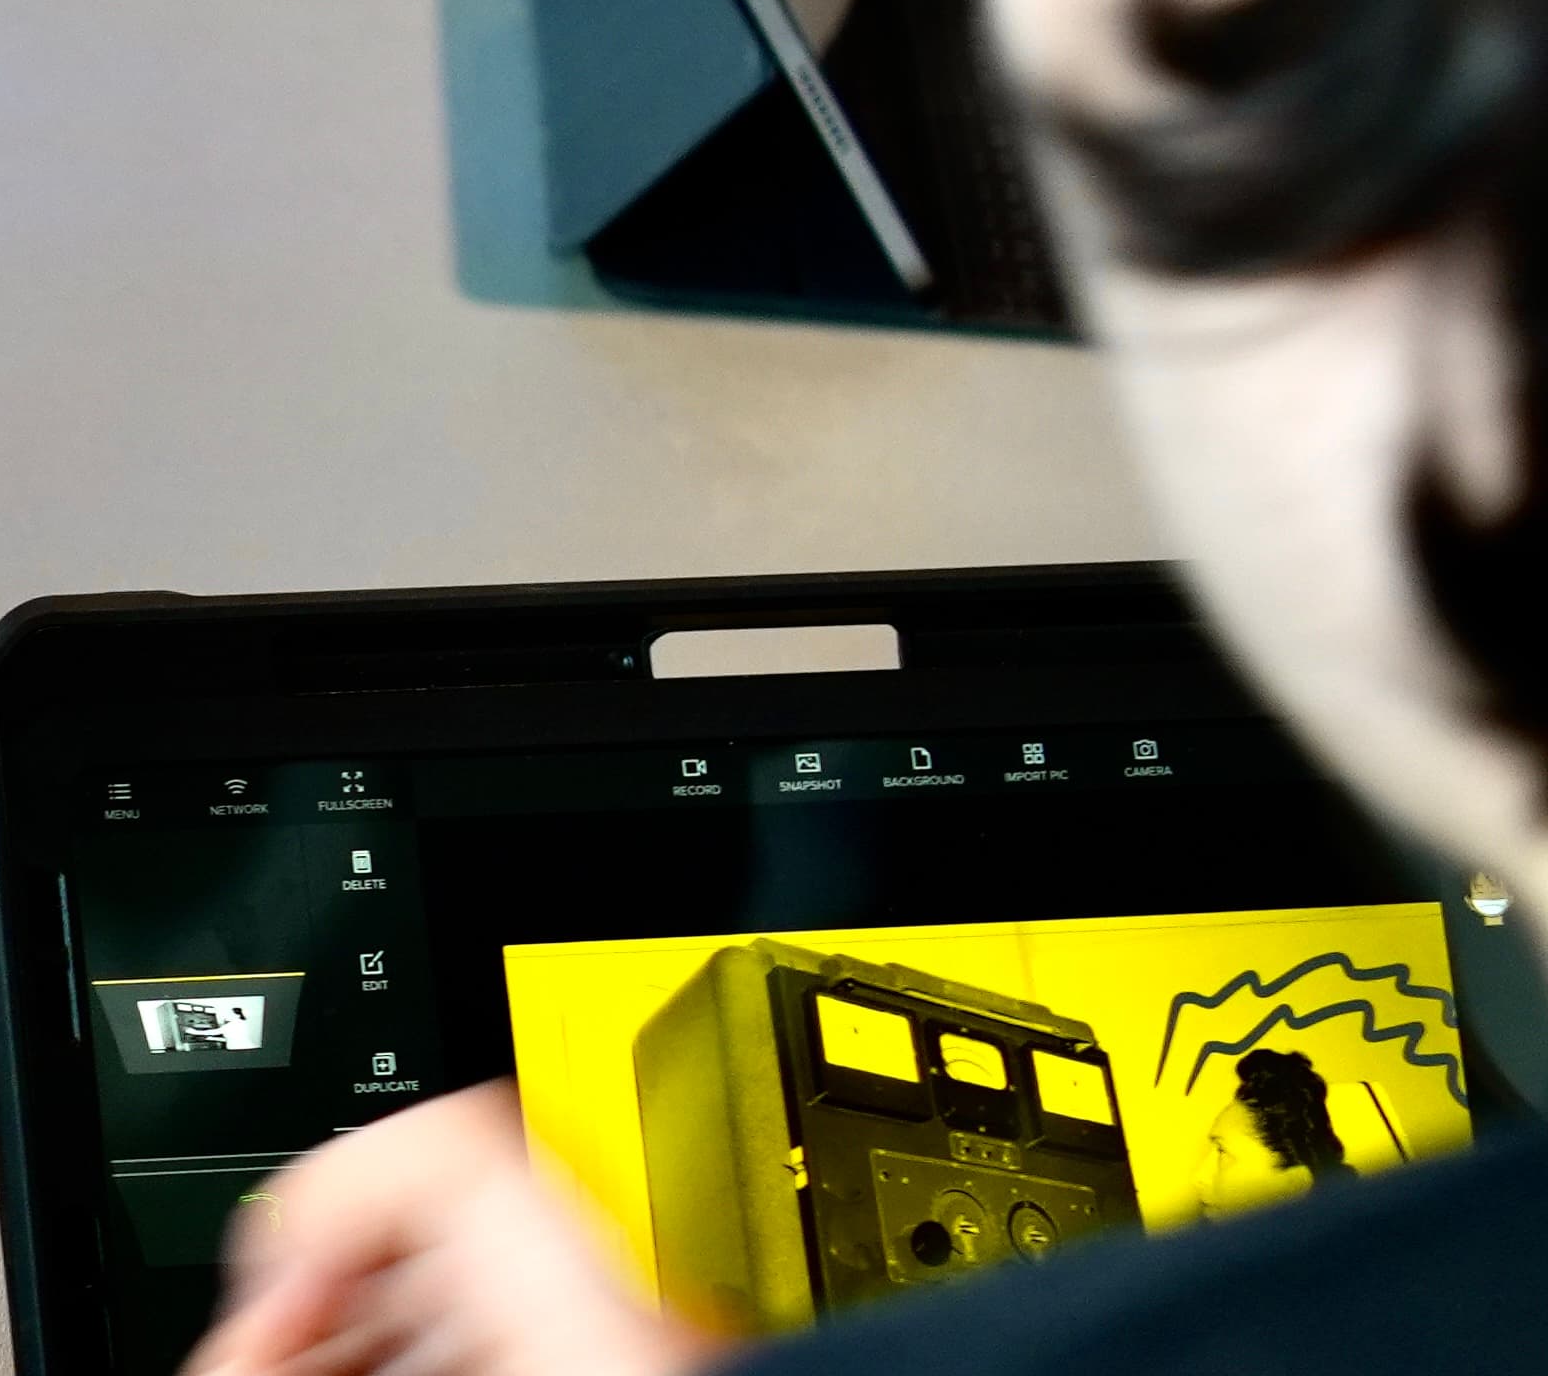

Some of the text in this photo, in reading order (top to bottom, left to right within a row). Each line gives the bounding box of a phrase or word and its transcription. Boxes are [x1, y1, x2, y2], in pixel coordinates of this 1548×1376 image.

[1004, 769, 1069, 782] IMPORT PIC
[1123, 765, 1173, 778] CAMERA
[778, 778, 842, 792] SNAPSHOT
[882, 774, 965, 788] BACKGROUND
[672, 784, 722, 797] RECORD
[209, 803, 269, 816] NETWORK
[317, 798, 393, 812] FULLSCREEN
[104, 809, 141, 820] MENU
[341, 878, 387, 891] DELETE
[361, 979, 389, 992] EDIT
[353, 1079, 420, 1094] DUPLICATE
